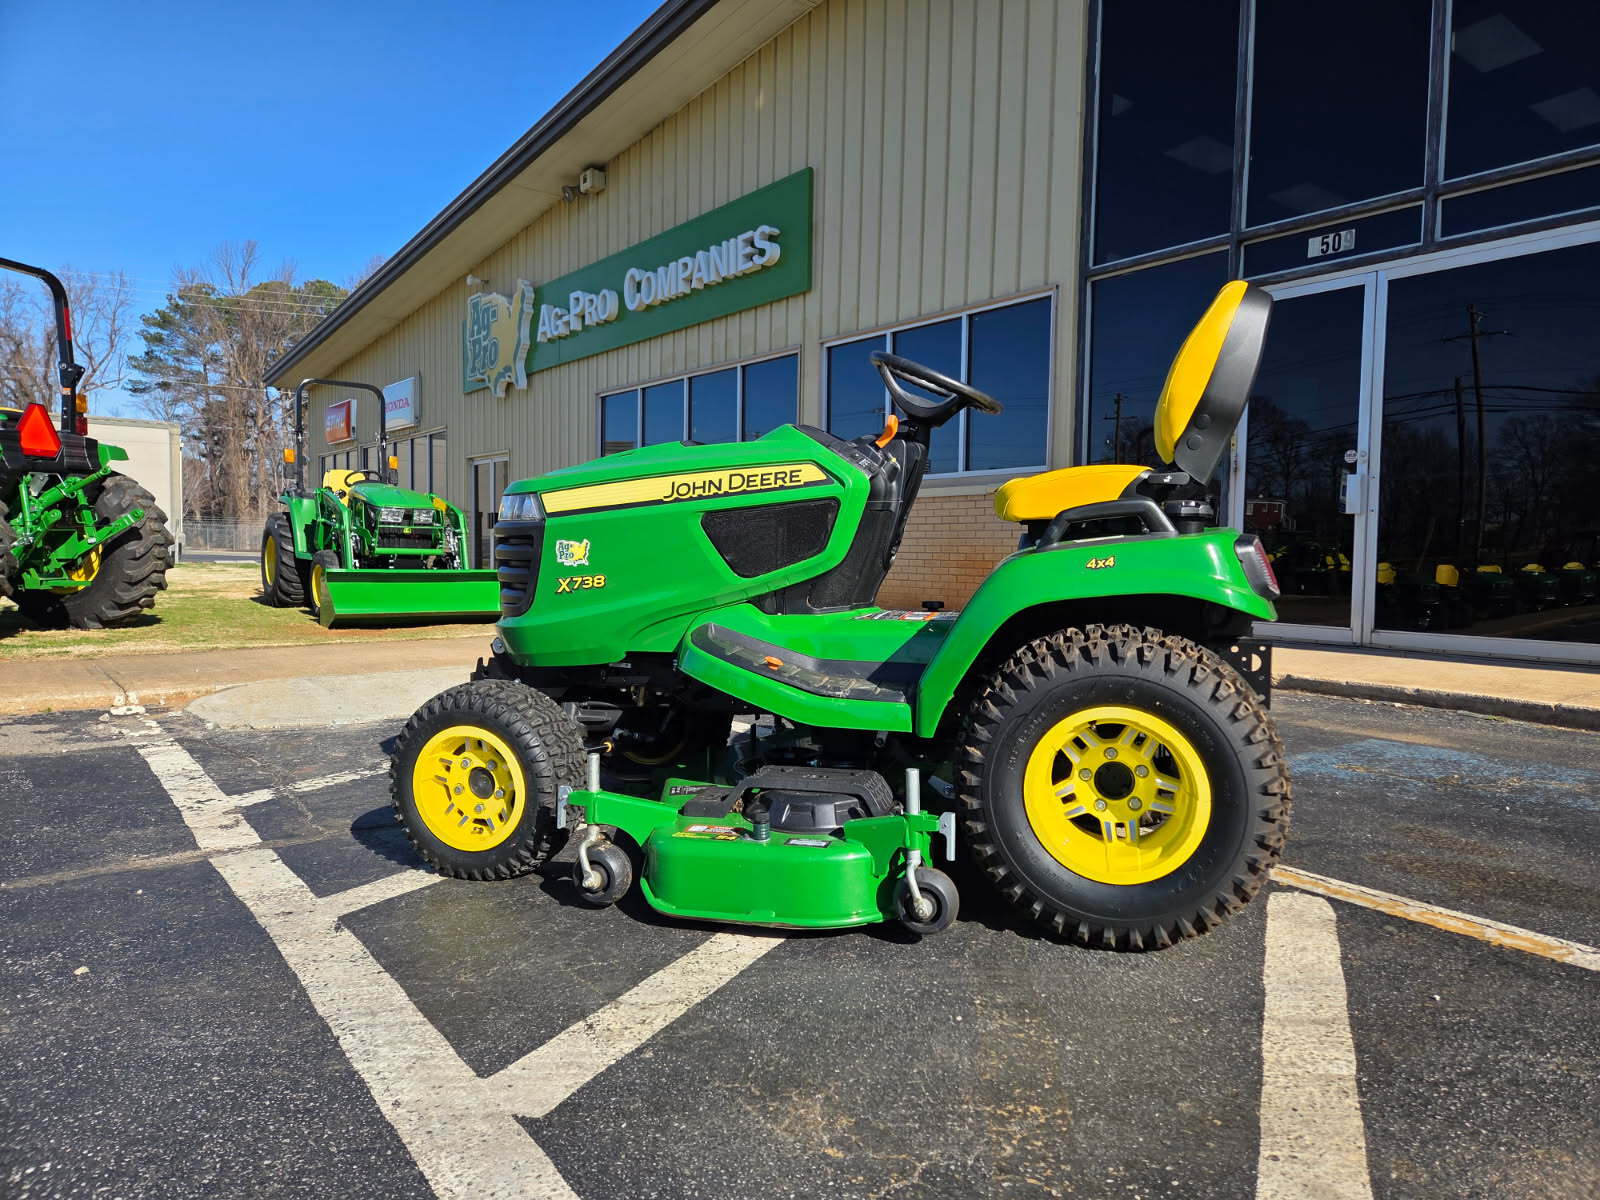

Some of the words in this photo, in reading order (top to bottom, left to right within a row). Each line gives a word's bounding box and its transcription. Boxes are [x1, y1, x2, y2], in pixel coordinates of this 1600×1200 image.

[623, 225, 781, 311] COMPANIES
[663, 478, 722, 499] JOHN
[728, 469, 803, 491] DEERE
[1086, 555, 1116, 570] 4x4
[555, 575, 606, 594] X738
